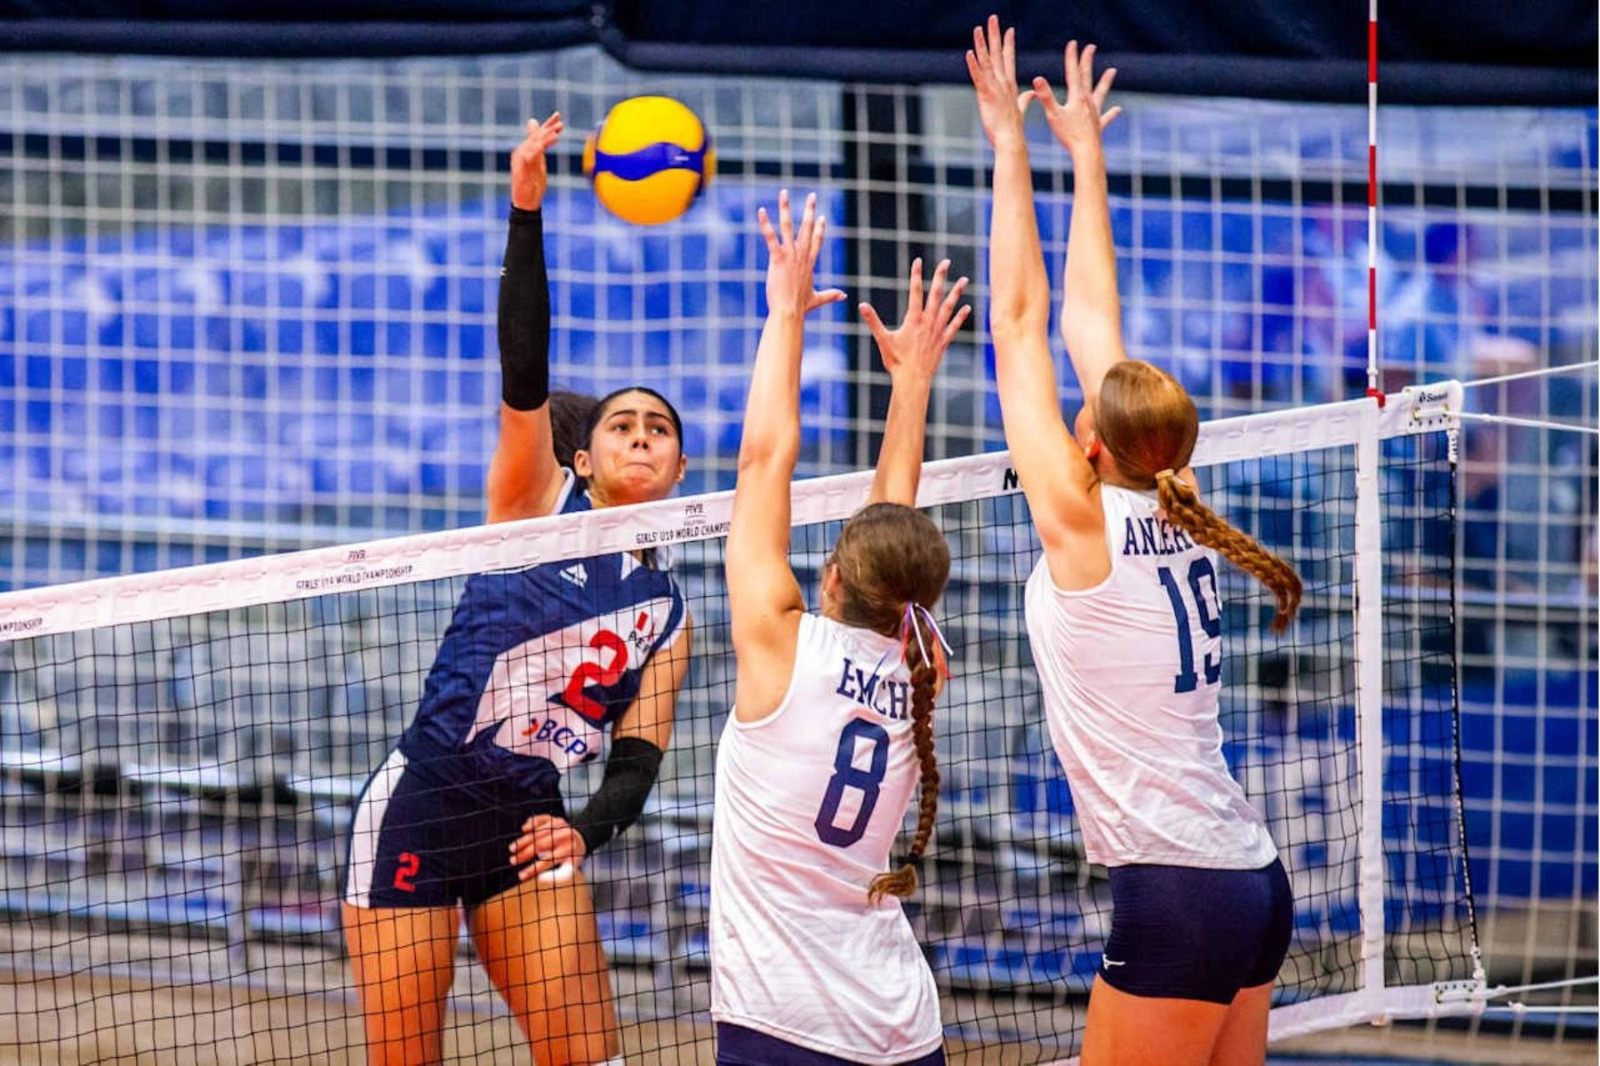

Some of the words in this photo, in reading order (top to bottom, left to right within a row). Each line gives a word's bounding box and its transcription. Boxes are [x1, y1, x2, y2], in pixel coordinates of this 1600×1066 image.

[676, 525, 700, 539] WORLD
[336, 571, 361, 585] WORLD
[1157, 556, 1222, 694] 19
[561, 629, 629, 721] 2
[536, 718, 588, 756] BCP
[814, 716, 891, 848] 8
[394, 852, 420, 893] 2
